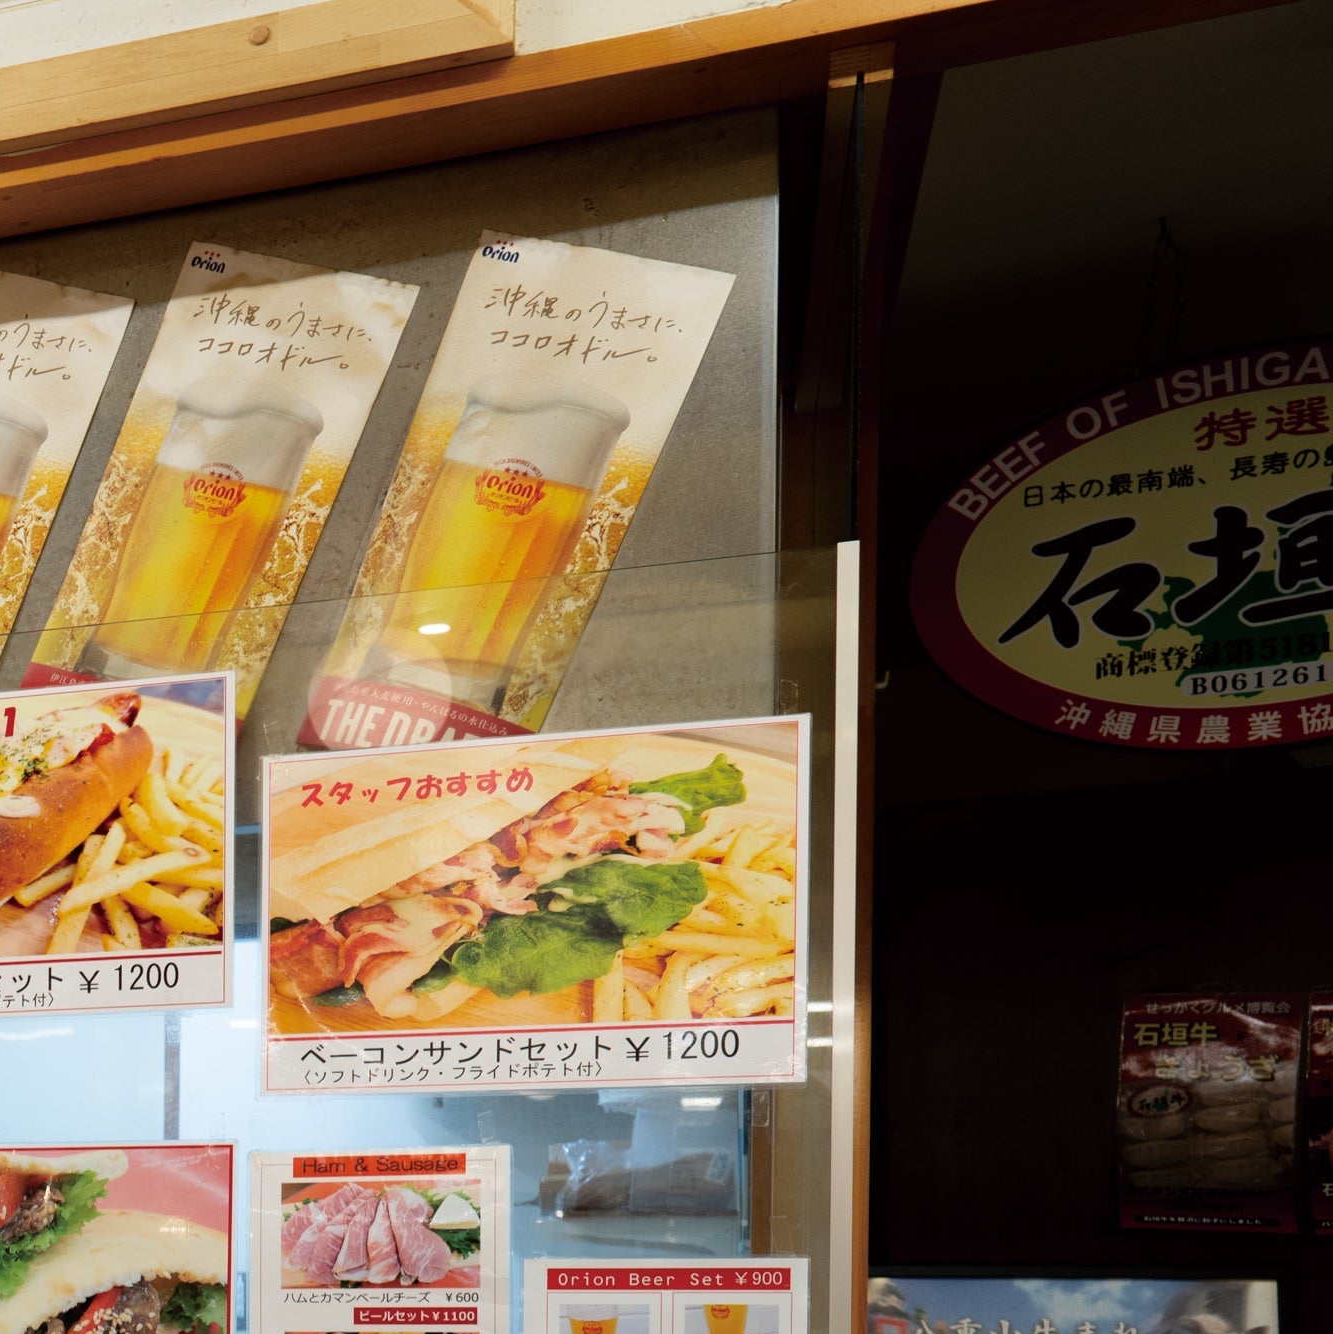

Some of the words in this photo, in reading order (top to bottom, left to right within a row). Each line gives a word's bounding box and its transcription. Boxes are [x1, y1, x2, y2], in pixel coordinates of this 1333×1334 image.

[191, 256, 225, 273] Orion
[482, 245, 520, 264] Orion
[1194, 395, 1330, 450] 特選
[947, 431, 1048, 521] BEEF
[1065, 389, 1130, 441] OF
[194, 478, 234, 501] Orion
[487, 475, 533, 498] Orion
[321, 698, 385, 748] THE
[300, 767, 534, 808] スタッフおすすめ
[78, 963, 179, 993] ¥1200
[1134, 1022, 1219, 1047] 石垣牛
[300, 1033, 612, 1066] ベーコンサンドセット
[626, 1029, 740, 1061] ¥1200
[302, 1159, 346, 1174] Ham
[354, 1158, 368, 1172] &
[376, 1157, 459, 1174] Sausage
[558, 1273, 616, 1286] Orion
[629, 1272, 675, 1286] Beer
[690, 1272, 724, 1286] Set
[735, 1271, 783, 1286] ¥900
[283, 1291, 431, 1304] ハムとカマンベールチーズ
[445, 1291, 480, 1304] ¥600
